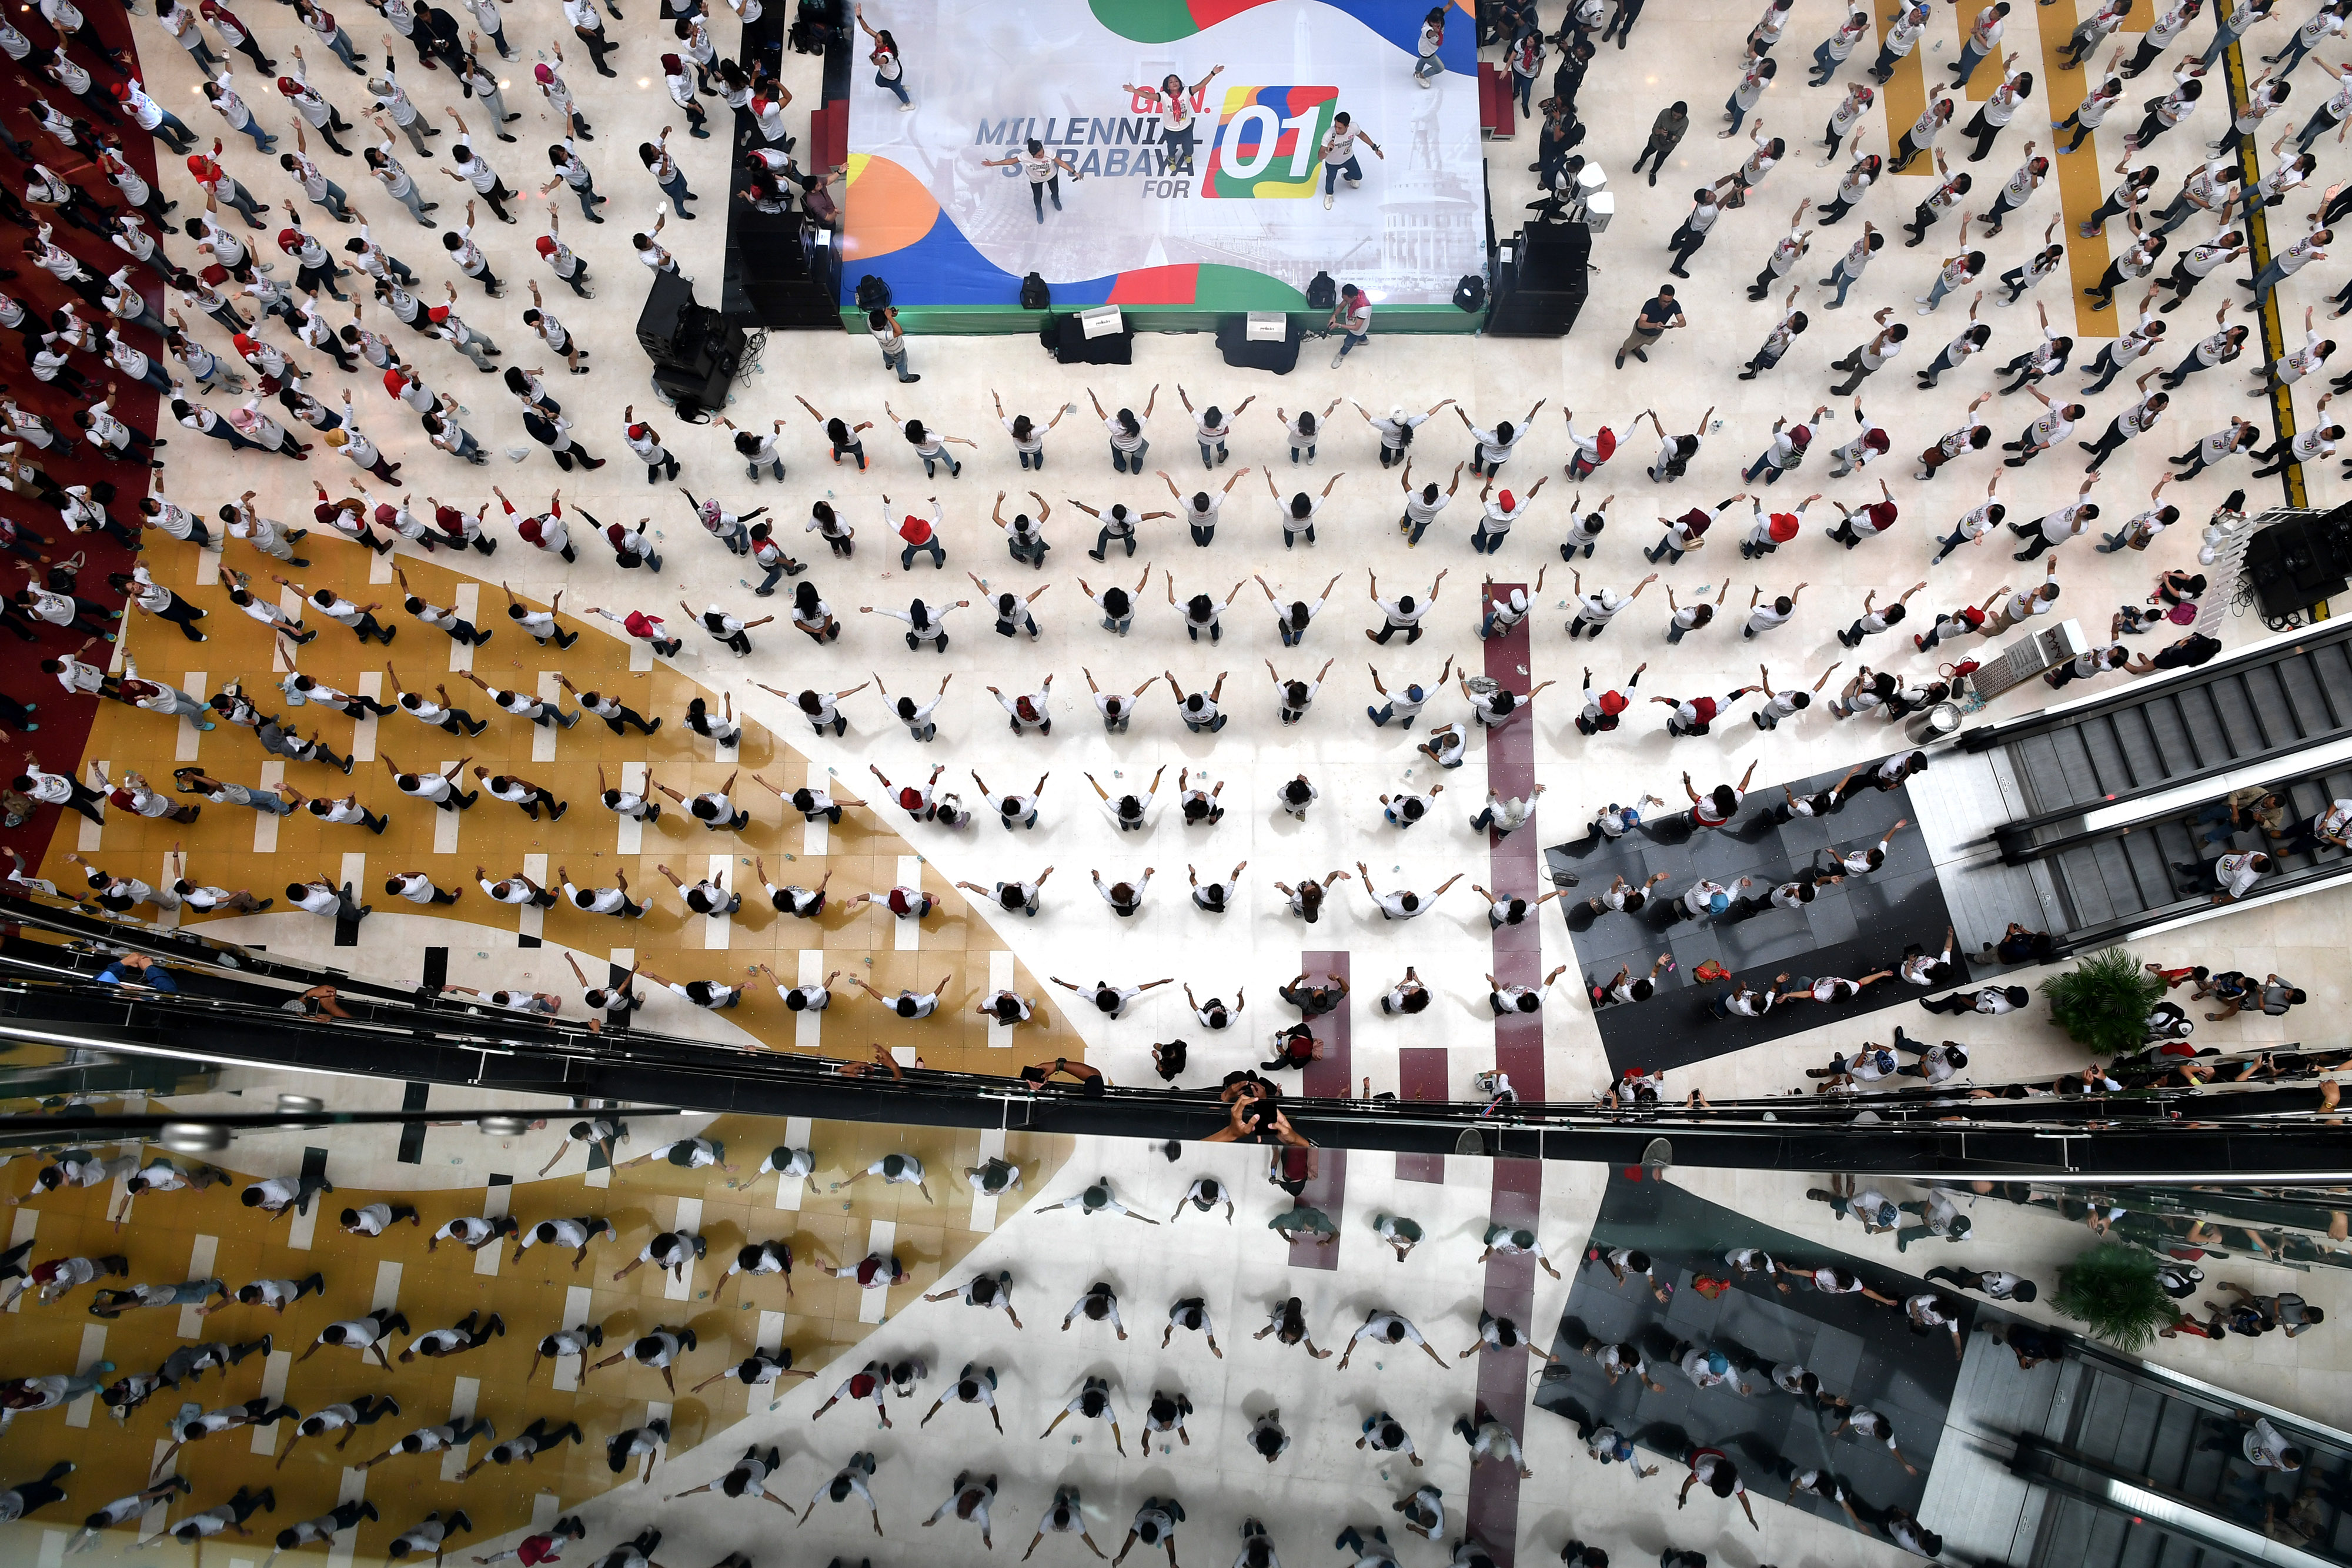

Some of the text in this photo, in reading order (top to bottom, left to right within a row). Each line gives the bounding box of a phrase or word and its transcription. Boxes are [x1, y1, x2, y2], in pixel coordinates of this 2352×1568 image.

[1219, 105, 1320, 179] 01
[1002, 149, 1194, 176] SRABAYA
[1142, 180, 1190, 198] FOR
[2039, 422, 2049, 433] 01
[2223, 857, 2233, 872] 01
